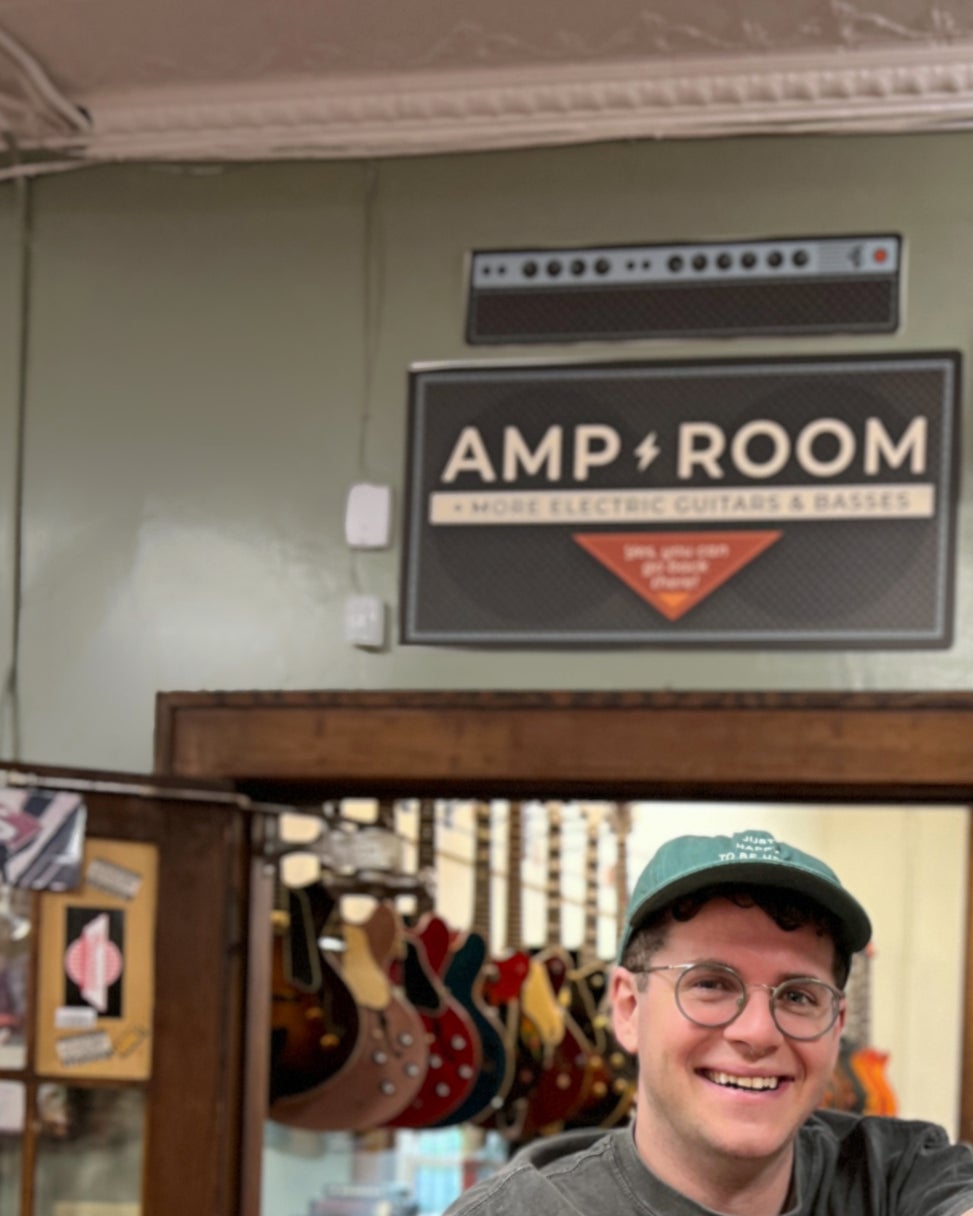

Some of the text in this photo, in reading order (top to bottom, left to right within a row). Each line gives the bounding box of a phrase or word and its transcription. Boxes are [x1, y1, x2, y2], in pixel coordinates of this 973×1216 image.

[440, 415, 928, 483] AMP ROOM
[471, 491, 910, 515] MORE ELECTRIC GUITARS & BASSES
